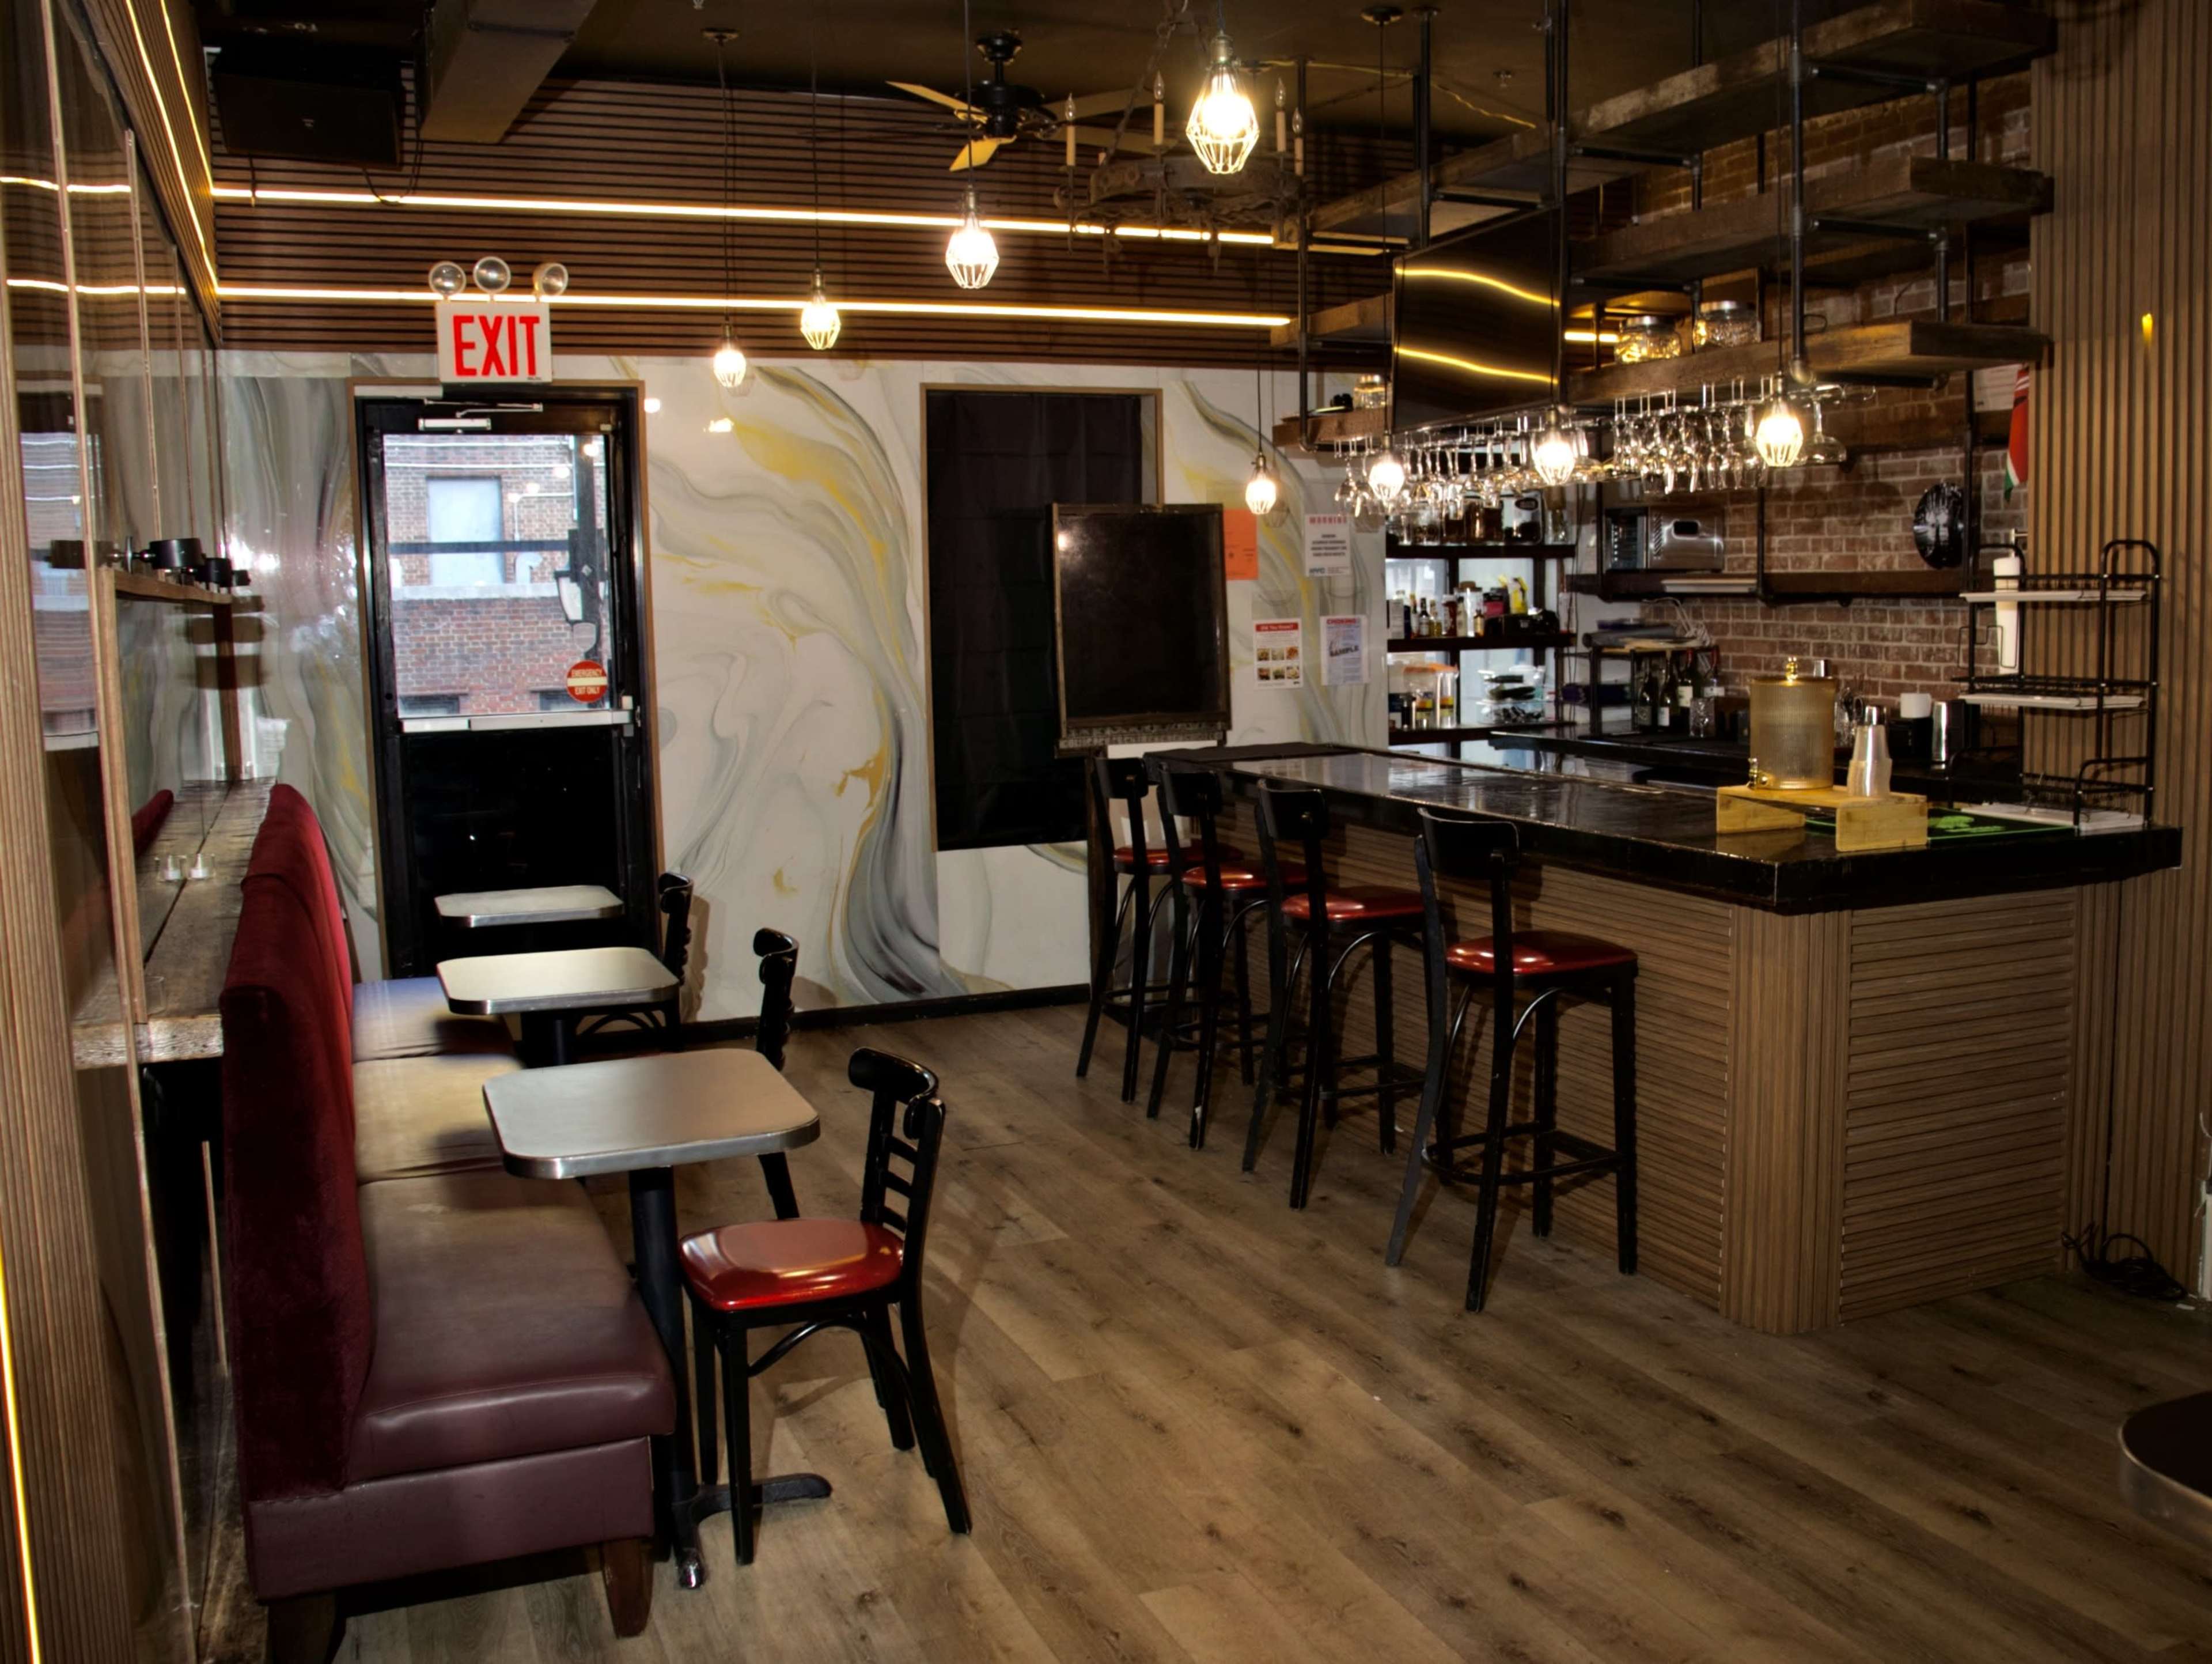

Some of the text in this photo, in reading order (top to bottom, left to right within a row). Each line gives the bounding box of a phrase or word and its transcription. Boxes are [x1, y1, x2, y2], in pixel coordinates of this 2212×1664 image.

[453, 315, 540, 377] EXIT
[571, 669, 603, 678] EMERGENCY
[574, 686, 600, 695] EXIT ONLY
